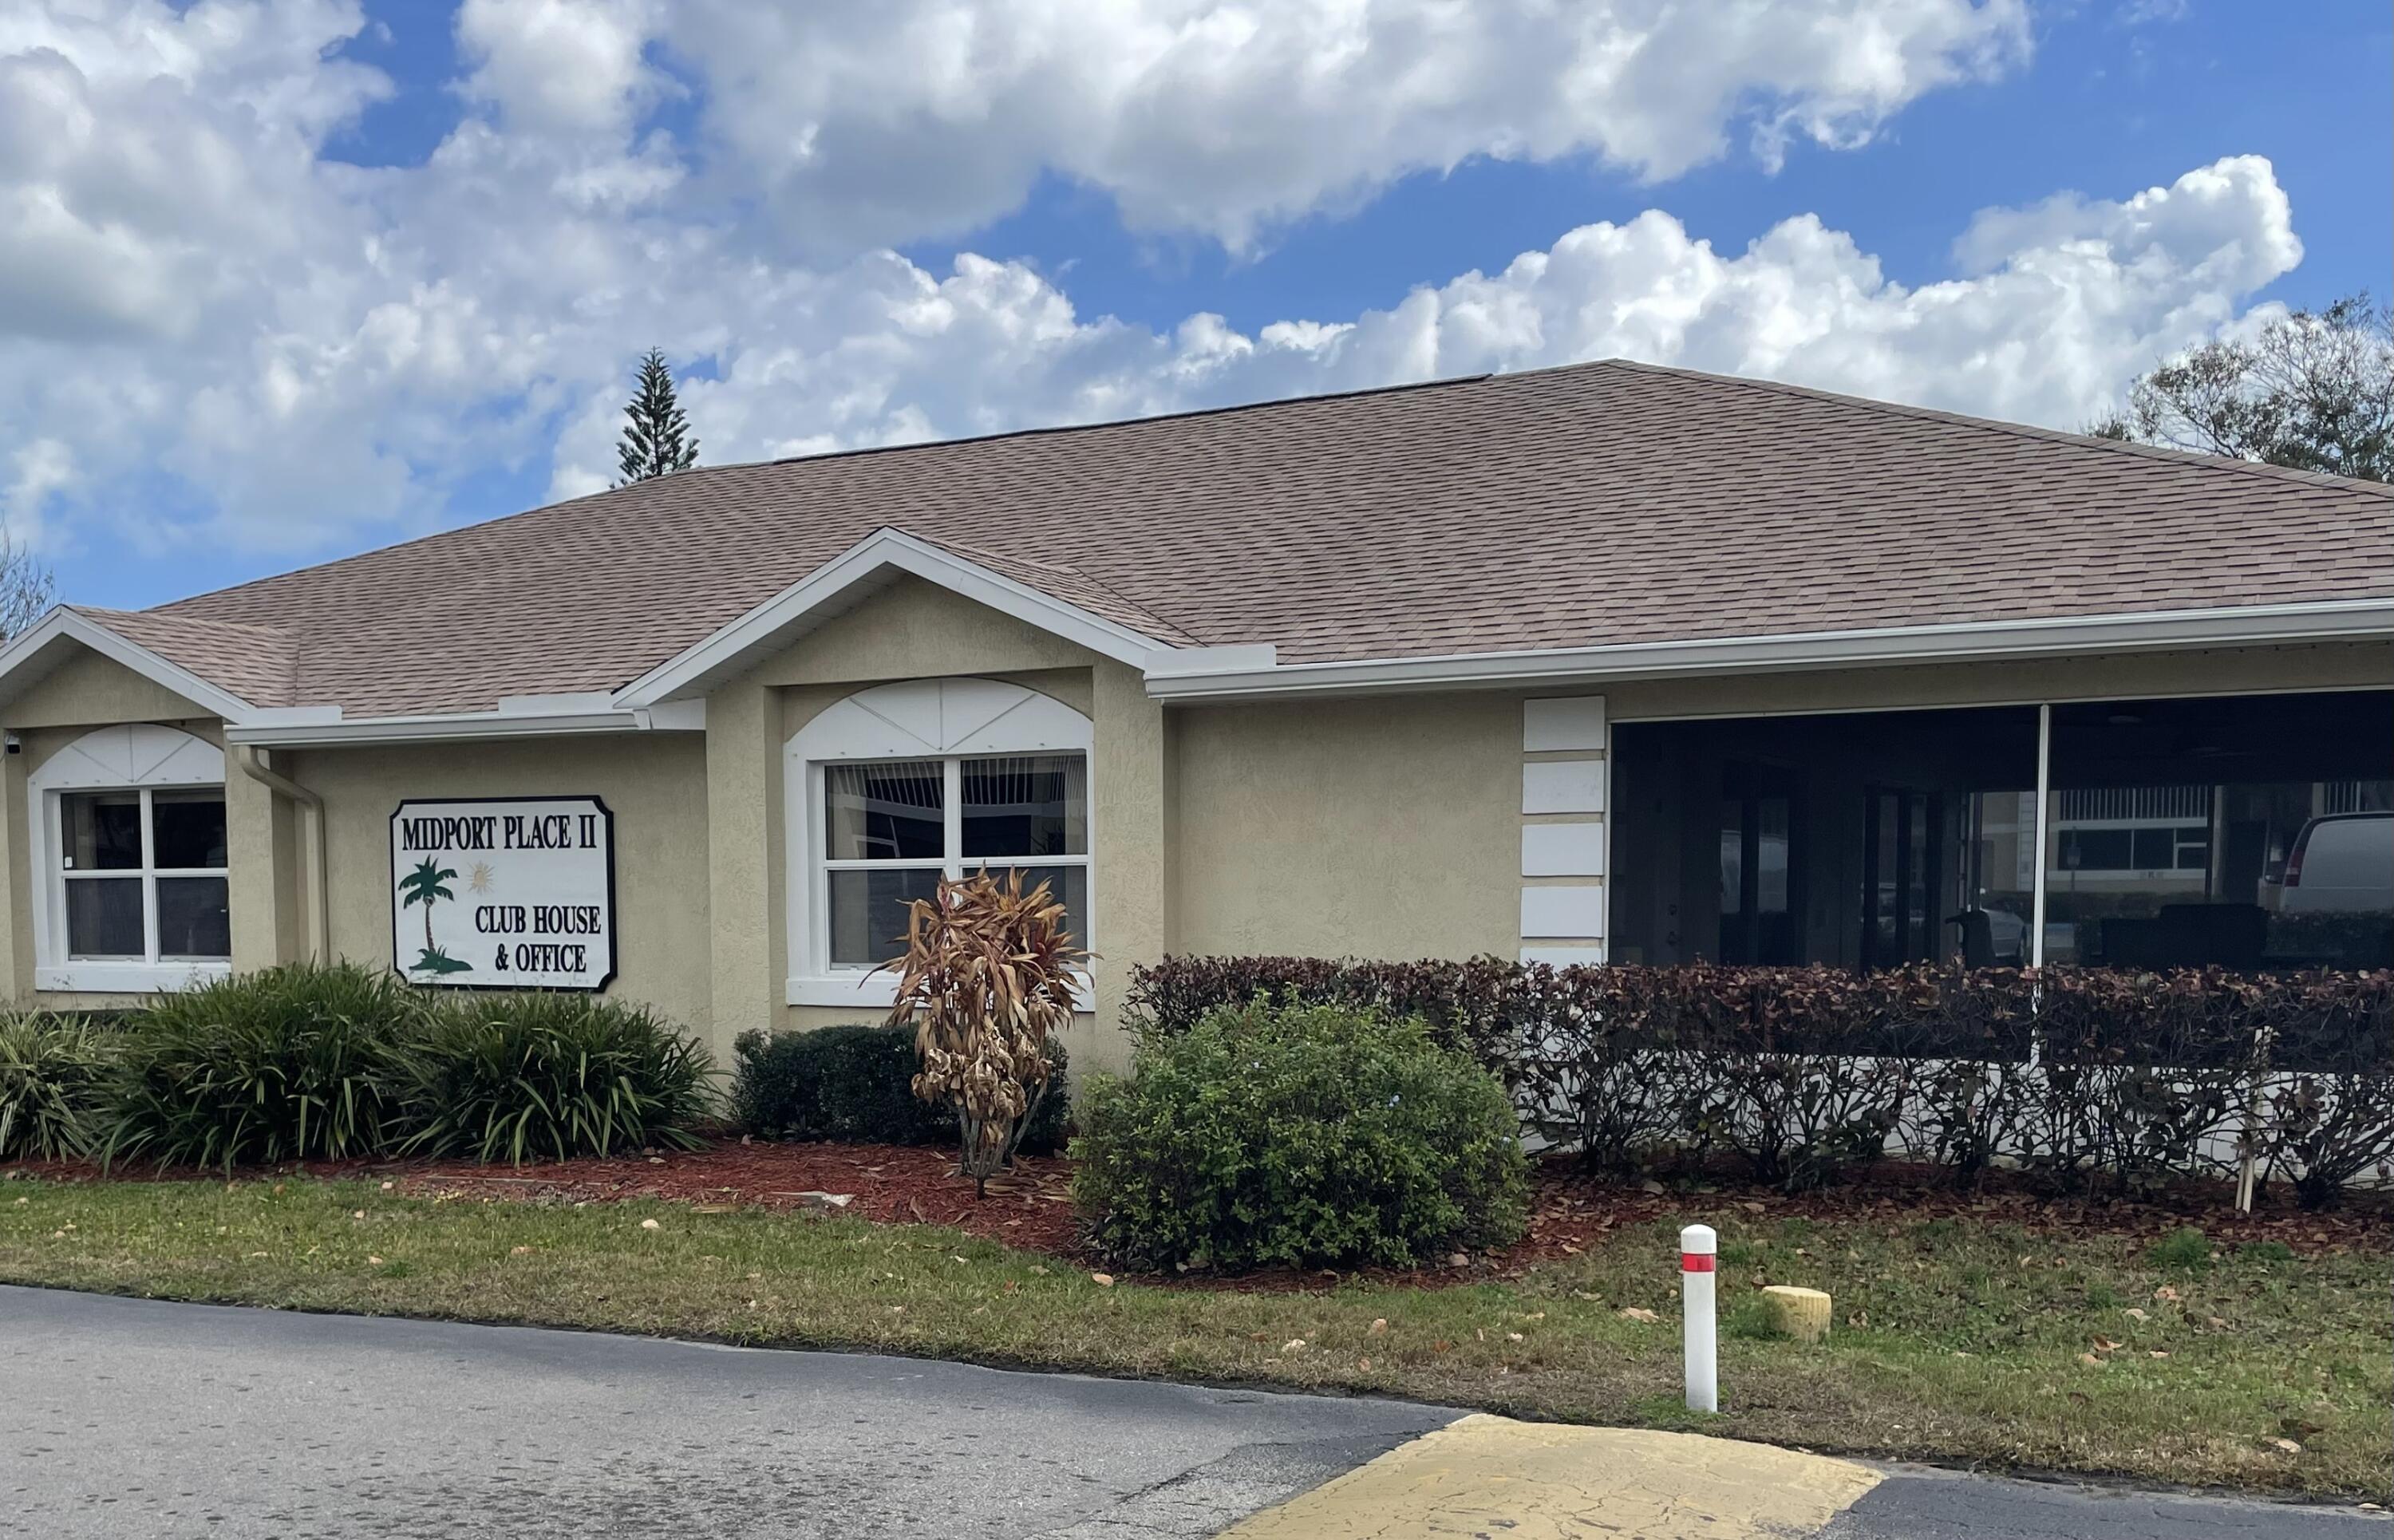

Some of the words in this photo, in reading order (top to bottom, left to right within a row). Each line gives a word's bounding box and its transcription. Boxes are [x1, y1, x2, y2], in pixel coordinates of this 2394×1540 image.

[402, 817, 496, 851] MIDPORT
[504, 815, 571, 849] PLACE
[579, 815, 597, 848] II
[476, 906, 526, 933] CLUB
[533, 906, 601, 934] HOUSE
[496, 943, 508, 970] &
[516, 943, 586, 973] OFFICE
